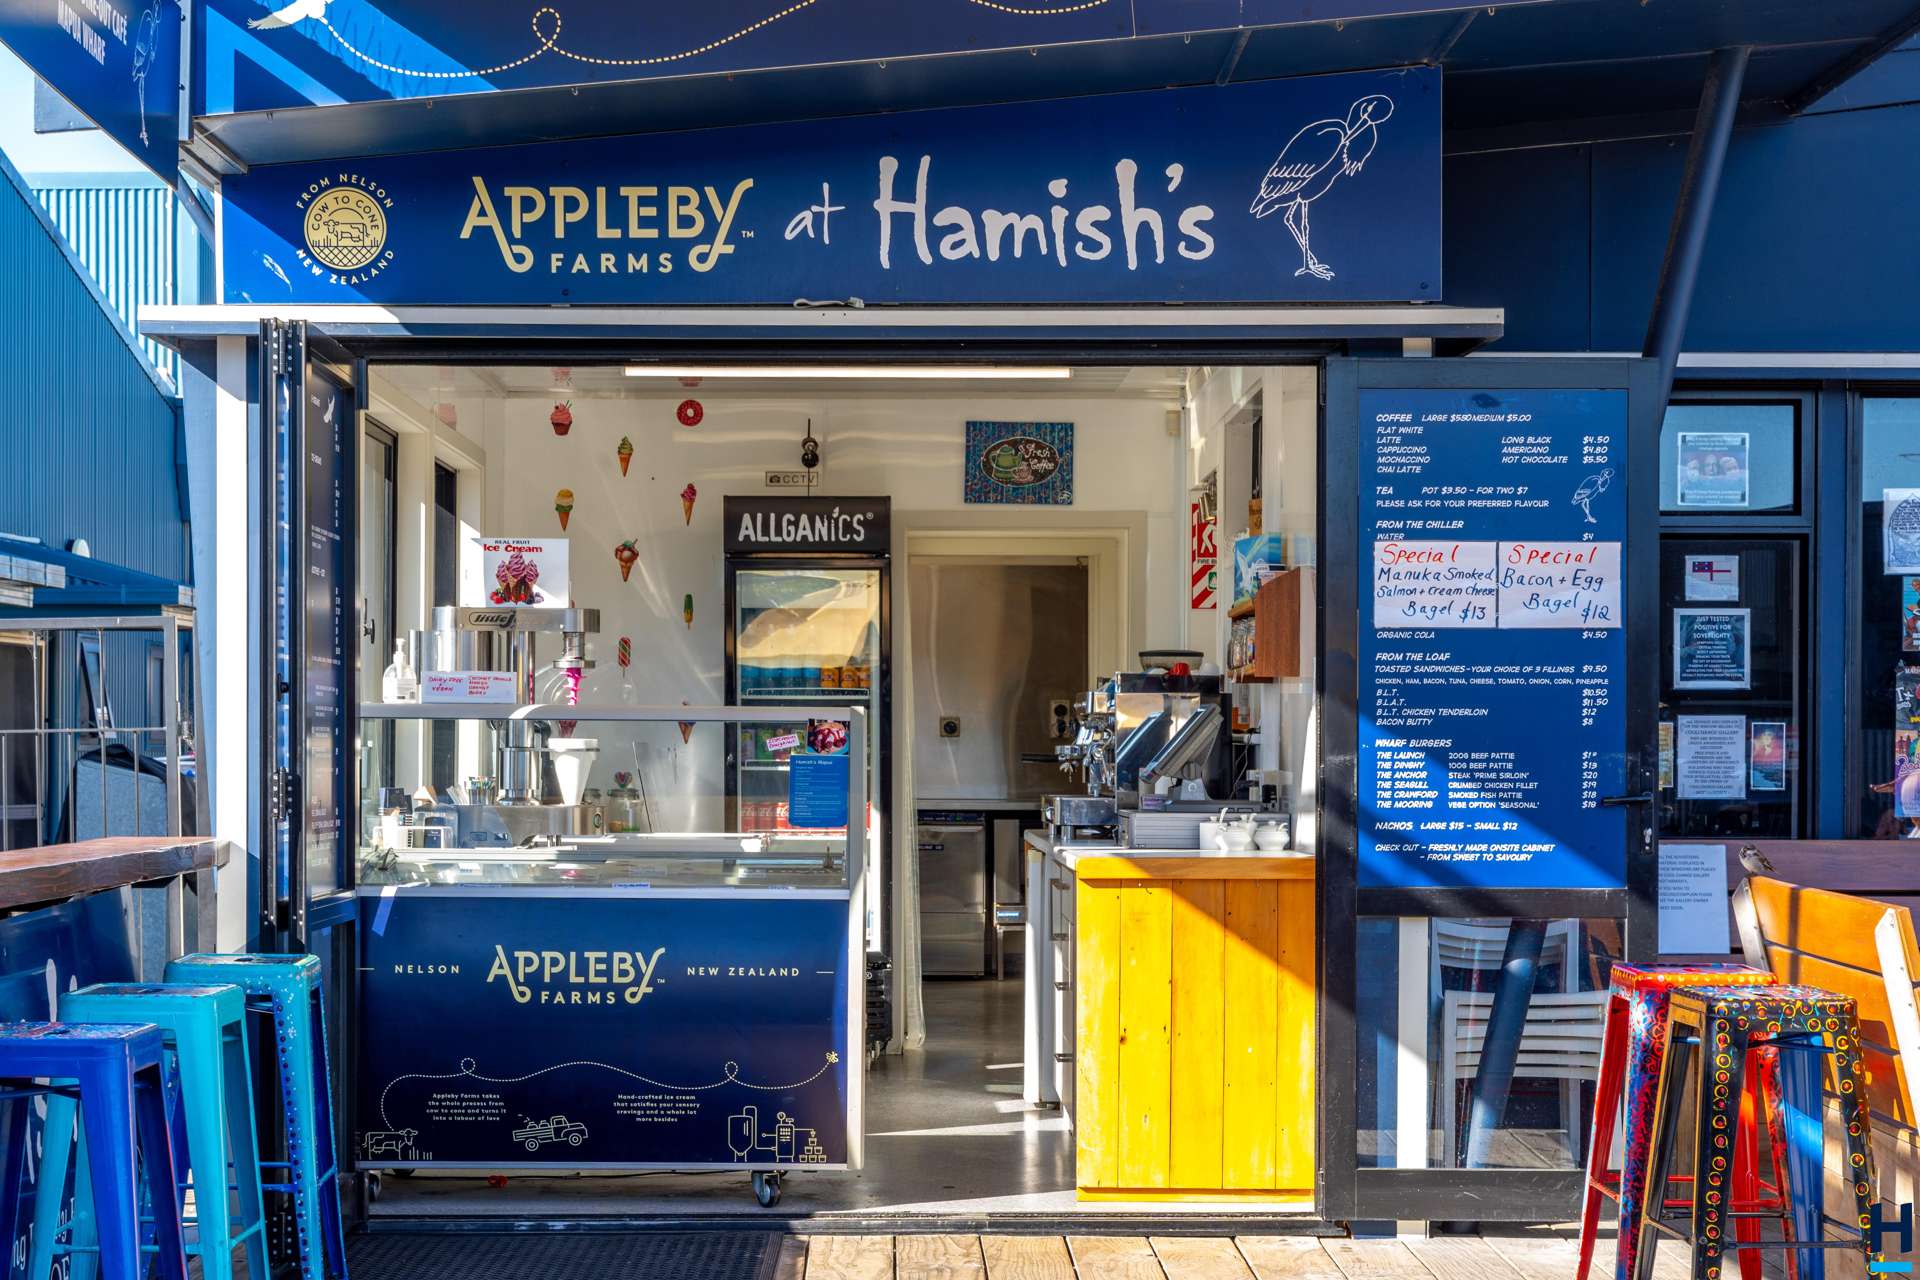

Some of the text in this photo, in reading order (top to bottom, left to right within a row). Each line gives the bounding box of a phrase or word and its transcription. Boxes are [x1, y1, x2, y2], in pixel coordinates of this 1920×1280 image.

[82, 20, 106, 66] WHARF
[296, 174, 394, 209] FROM NELSON
[312, 195, 380, 231] COW TO CONE
[784, 155, 1215, 270] at Hamish's
[459, 176, 754, 274] APPLEBY
[296, 248, 394, 285] NEW ZEALAND
[551, 253, 673, 274] FARMS
[1375, 413, 1532, 422] COFFEE LARGE $5.00
[1376, 426, 1424, 434] FLAT WHITE
[1376, 436, 1402, 444] LATTE
[1501, 436, 1552, 444] LONG BLACK
[1582, 435, 1610, 445] $4.50
[1376, 446, 1427, 454] CAPPUCCINO
[1501, 446, 1550, 454] AMERICANO
[1582, 445, 1608, 455] $4.80
[1376, 455, 1431, 464] MOCHACCINO
[1501, 455, 1569, 464] HOT CHOCOLATE
[1376, 465, 1422, 473] CHAI LATTE
[782, 474, 816, 484] CCTV
[1376, 486, 1529, 495] TEA POT FOR TWO $7
[1375, 499, 1550, 508] PLEASE ASK FOR YOUR PREFERRED FLAVOUR
[1375, 520, 1465, 529] FROM THE CHILLER
[1376, 533, 1405, 541] WATER
[1582, 533, 1594, 541] $4
[482, 544, 543, 553] Ice Cream
[1380, 544, 1459, 565] Special
[1508, 544, 1598, 564] Special
[1378, 567, 1495, 582] Manuka Smoked
[1500, 567, 1604, 592] Bacon Egg
[1377, 585, 1417, 598] Salmon
[1402, 600, 1487, 623] Bagel $13
[1523, 592, 1612, 623] Bagel $12
[1376, 631, 1435, 639] ORGANIC COLA
[1582, 630, 1608, 640] $4.50
[1375, 652, 1451, 661] FROM THE LOAF
[1374, 665, 1575, 674] TOASTED CHOICE FILLINGS
[1582, 664, 1608, 673] $9.50
[1376, 688, 1399, 697] B.L.T.
[1376, 698, 1407, 706] B.L.A.T.
[1582, 697, 1609, 707] $11.50
[1376, 708, 1489, 716] B.L.T. CHICKEN TENDERLOIN
[1581, 707, 1597, 717] $12
[1375, 717, 1434, 726] BACON BUTTY
[1582, 717, 1593, 727] $8
[1374, 738, 1453, 748] WHARF BURGERS
[1376, 751, 1426, 760] THE LAUNCH
[1491, 752, 1515, 760] PATTIE
[1376, 761, 1392, 769] THE
[1376, 770, 1428, 779] THE ANCHOR
[1582, 771, 1598, 779] $20
[1376, 780, 1429, 789] THE SEAGULL
[1447, 781, 1482, 789] CRUMBED
[1376, 790, 1439, 799] THE CRAWFORD
[1448, 791, 1523, 799] SMOKED FISH PATTIE
[1376, 800, 1434, 809] THE MOORING
[1468, 801, 1496, 809] OPTION
[1375, 821, 1518, 831] NACHOS LARGE $15 SMALL $12
[1375, 843, 1556, 852] CHECK OUT FRESHLY MADE ONSITE CABINET
[1427, 853, 1533, 862] FROM SWEET TO SAVOURY
[394, 964, 461, 974] NELSON
[687, 966, 800, 976] NEW ZEALAND
[486, 944, 666, 1004] APPLEBY
[541, 991, 616, 1005] FARMS
